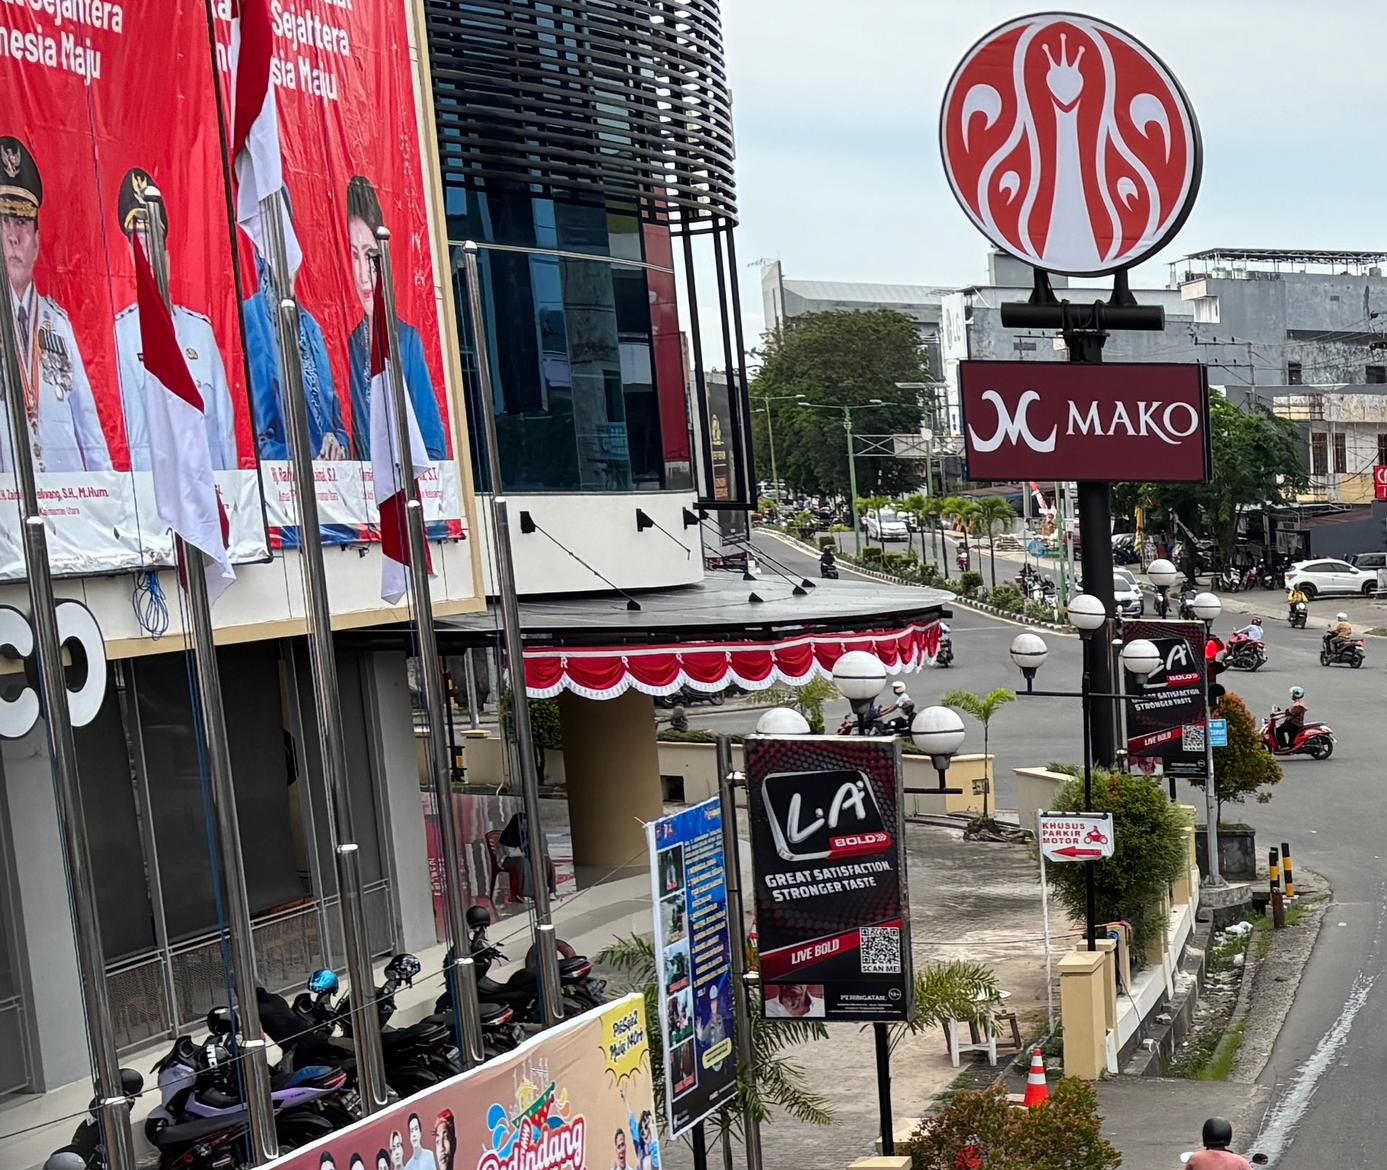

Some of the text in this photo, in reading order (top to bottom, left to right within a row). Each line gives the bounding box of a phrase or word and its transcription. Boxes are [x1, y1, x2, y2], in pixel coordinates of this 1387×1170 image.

[61, 30, 102, 86] Maju
[1065, 400, 1199, 445] MAKO
[1042, 822, 1085, 830] KHUSUS
[834, 834, 877, 848] BOLD
[764, 870, 812, 888] GREAT
[772, 876, 877, 902] STRONGER TASTE
[791, 938, 840, 965] LIVE BOLD
